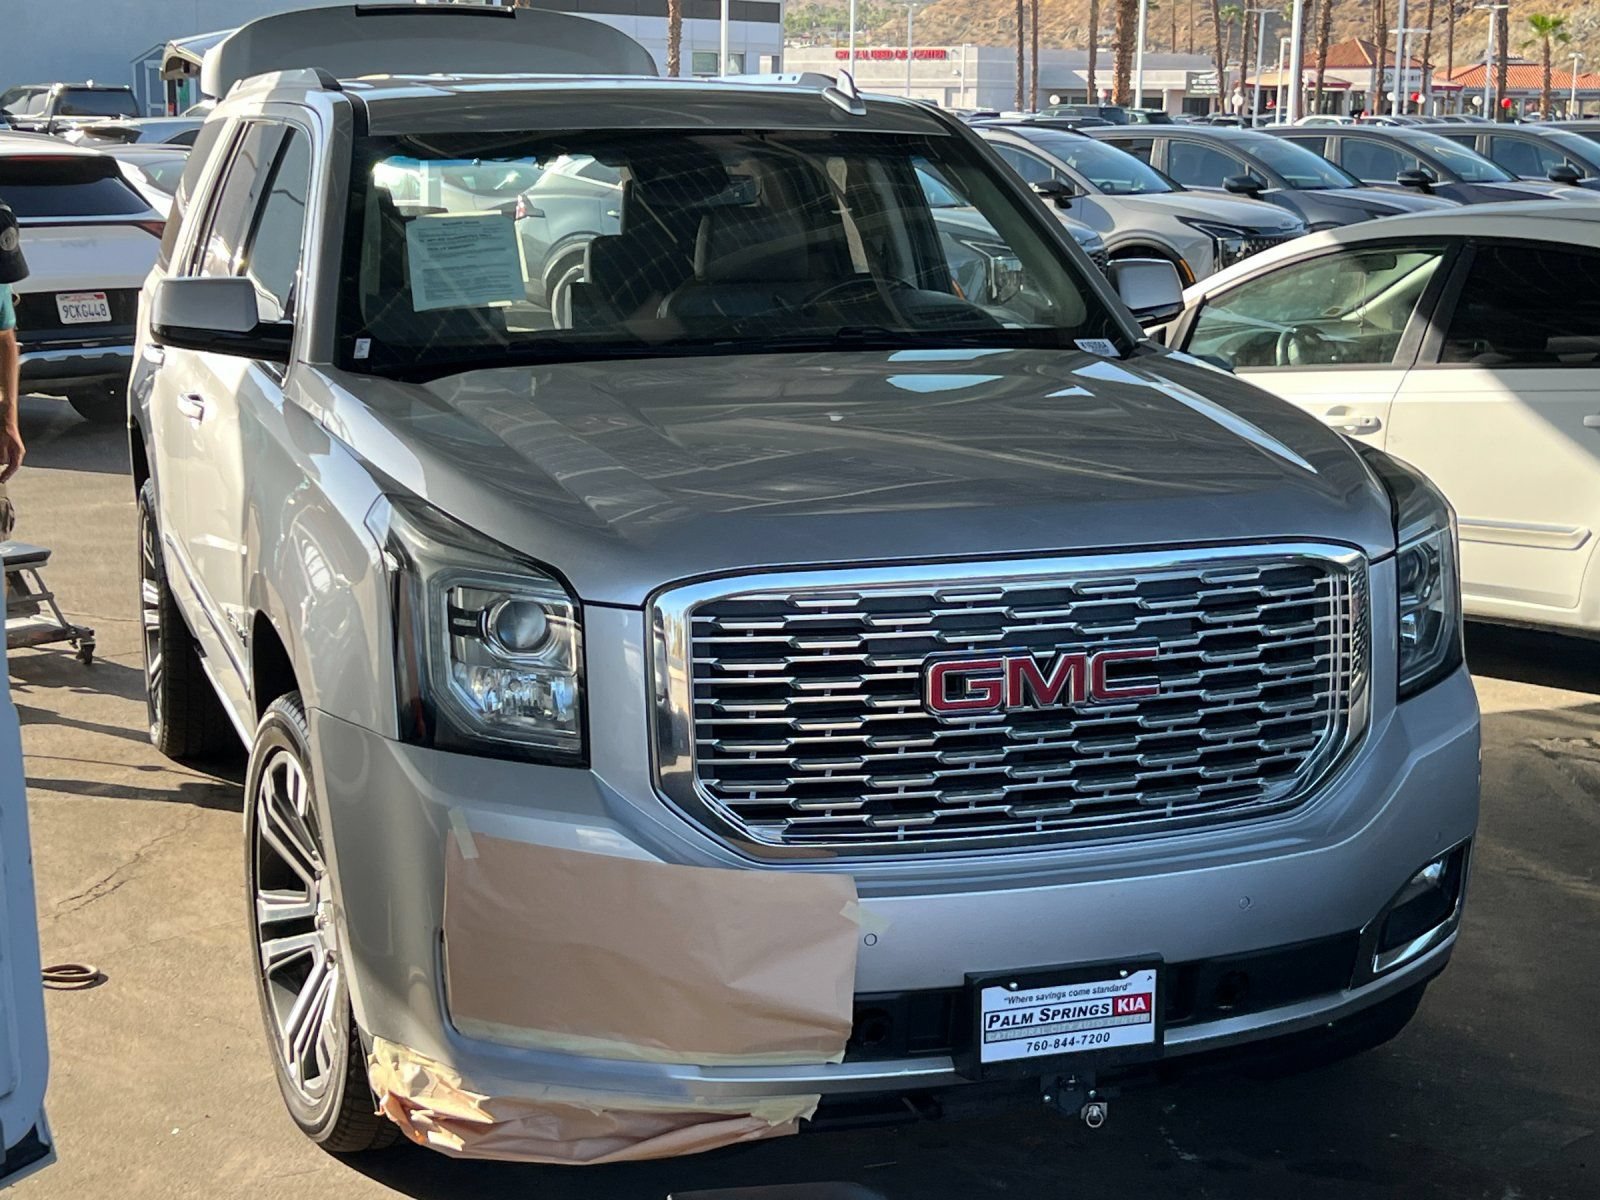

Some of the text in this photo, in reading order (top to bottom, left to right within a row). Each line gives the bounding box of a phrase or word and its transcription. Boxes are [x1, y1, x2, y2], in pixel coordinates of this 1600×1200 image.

[836, 50, 869, 60] CRYTAL
[62, 303, 107, 319] 9CKG448
[928, 646, 1161, 712] GMC
[1036, 991, 1066, 1002] savings
[1069, 988, 1090, 997] come
[987, 996, 1146, 1029] PALM SPRINGS KIA
[1026, 1032, 1111, 1052] 760-844-7200
